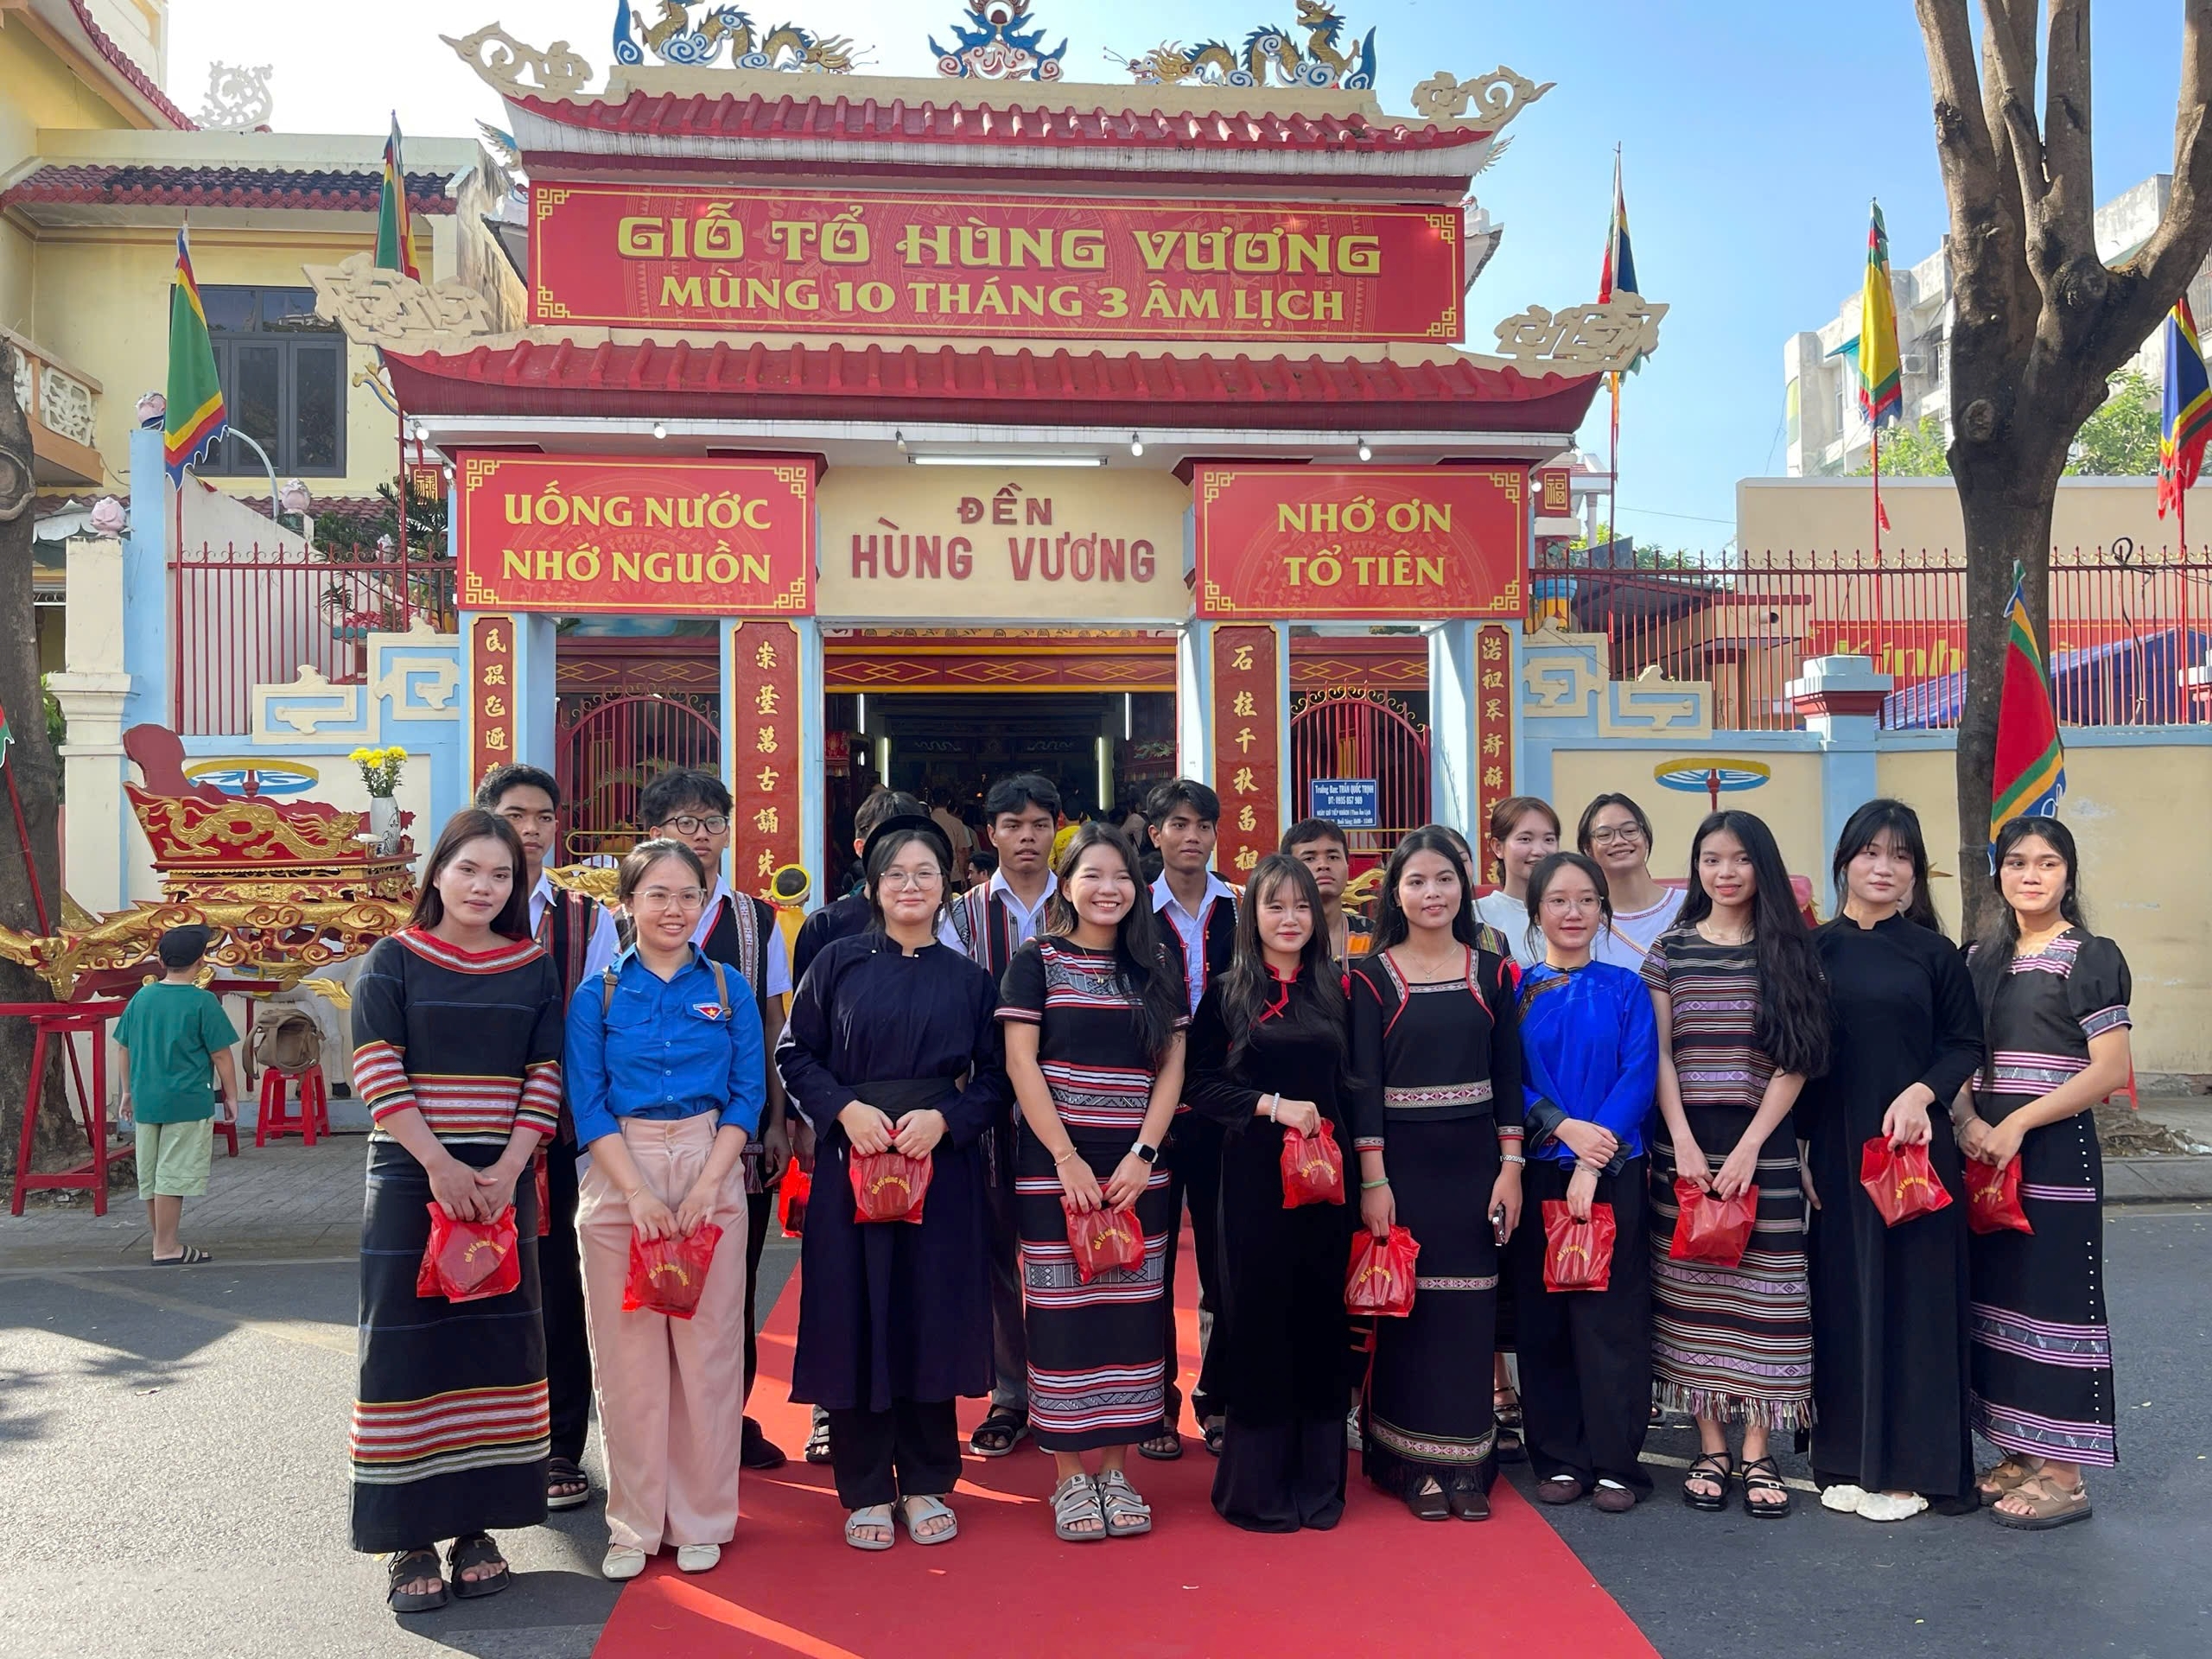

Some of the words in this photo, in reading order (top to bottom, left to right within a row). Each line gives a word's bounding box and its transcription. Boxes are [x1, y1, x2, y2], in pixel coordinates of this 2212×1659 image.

[618, 202, 744, 259] GIỖ
[771, 206, 870, 263] TỔ
[895, 216, 1105, 270] HÙNG
[1134, 226, 1380, 275] VƯƠNG
[659, 268, 818, 310] MÙNG
[836, 282, 895, 312] 10
[909, 275, 1082, 317] THÁNG
[1098, 287, 1128, 318] 3
[1141, 279, 1220, 320] ÂM
[1230, 289, 1344, 328] LỊCH
[504, 480, 632, 527] UỐNG
[645, 491, 771, 531] NƯỚC
[957, 482, 1052, 525] ĐỀN
[1277, 495, 1376, 533] NHỚ
[1385, 498, 1452, 534] ƠN
[502, 543, 601, 582] NHỚ
[611, 539, 772, 585] NGUỒN
[851, 517, 973, 580] HÙNG
[1008, 531, 1155, 583] VƯƠNG
[1283, 544, 1343, 587] TỔ
[1351, 549, 1446, 587] TIÊN
